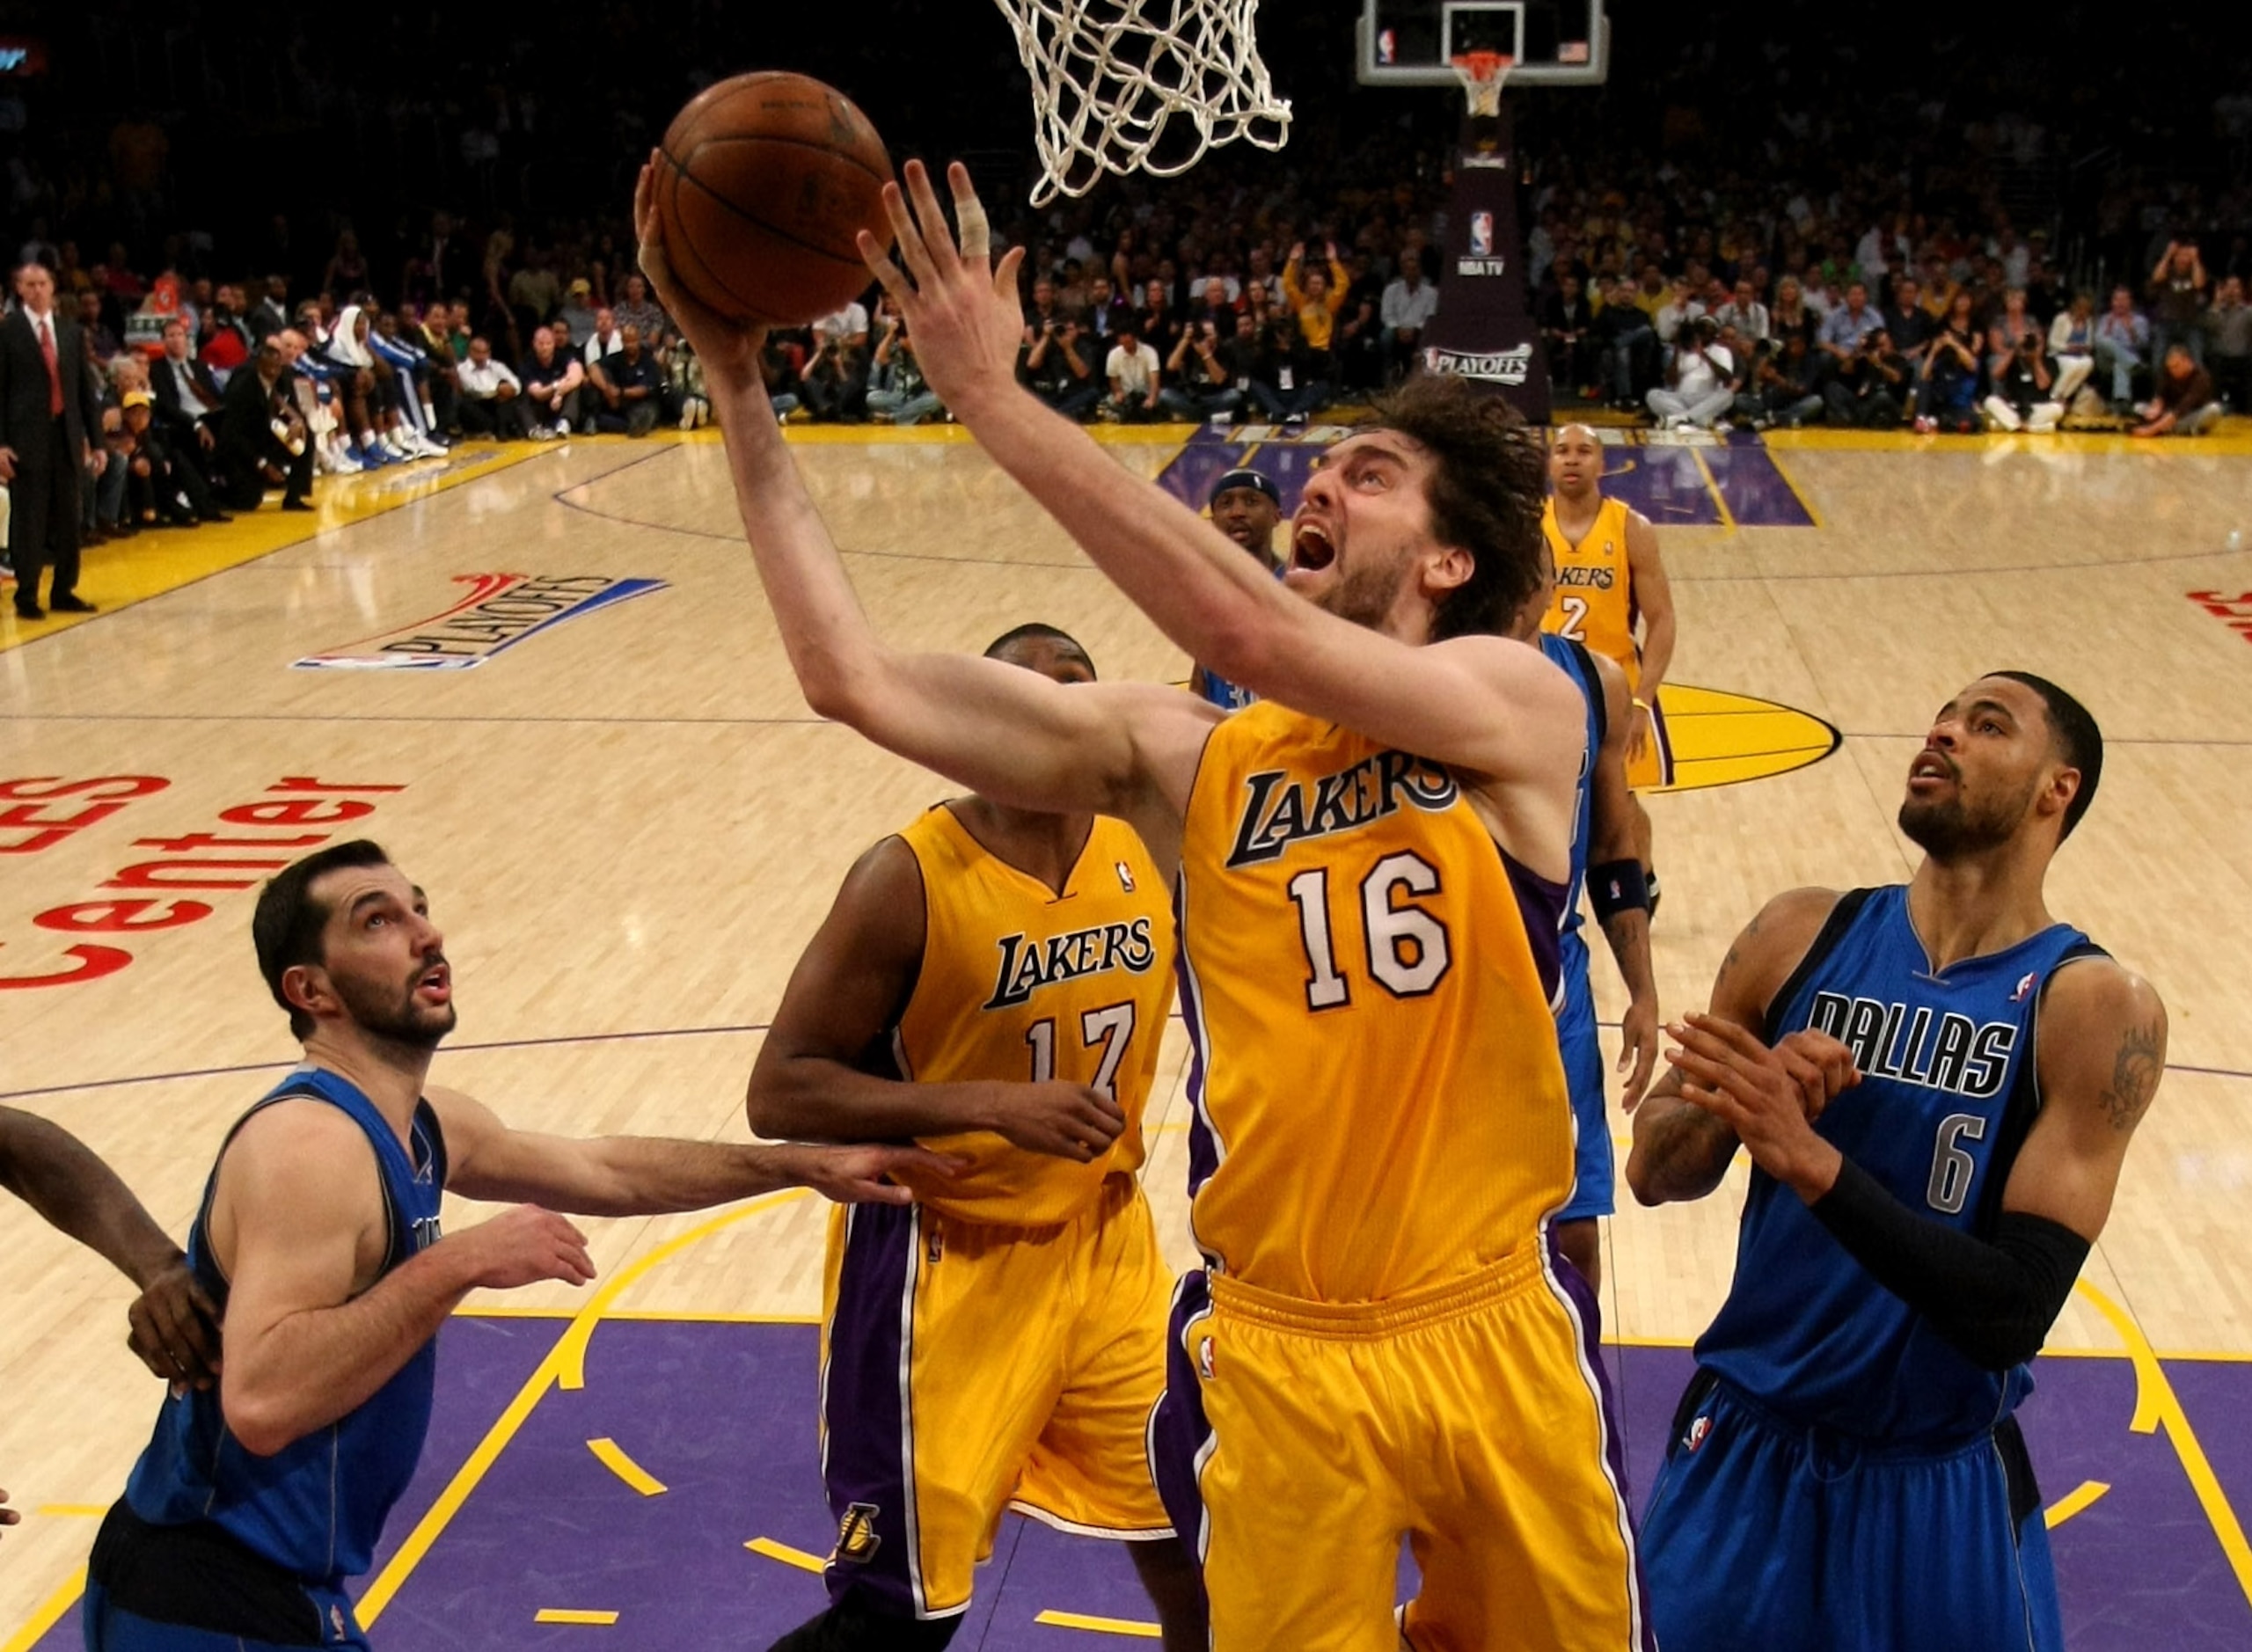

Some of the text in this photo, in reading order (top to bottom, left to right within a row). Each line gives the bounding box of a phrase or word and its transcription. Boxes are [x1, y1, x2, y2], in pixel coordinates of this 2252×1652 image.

[1458, 261, 1504, 275] NBA TV
[1437, 355, 1528, 375] PLAYOFFS
[380, 575, 613, 655] PLAYOFFS
[1560, 596, 1590, 642] 2
[1226, 748, 1460, 868] LAKERS
[981, 917, 1155, 1012] LAKERS
[1287, 847, 1453, 1012] 16
[1026, 999, 1135, 1101] 17
[1808, 990, 2018, 1098] DALLAS
[1927, 1113, 1985, 1214] 6
